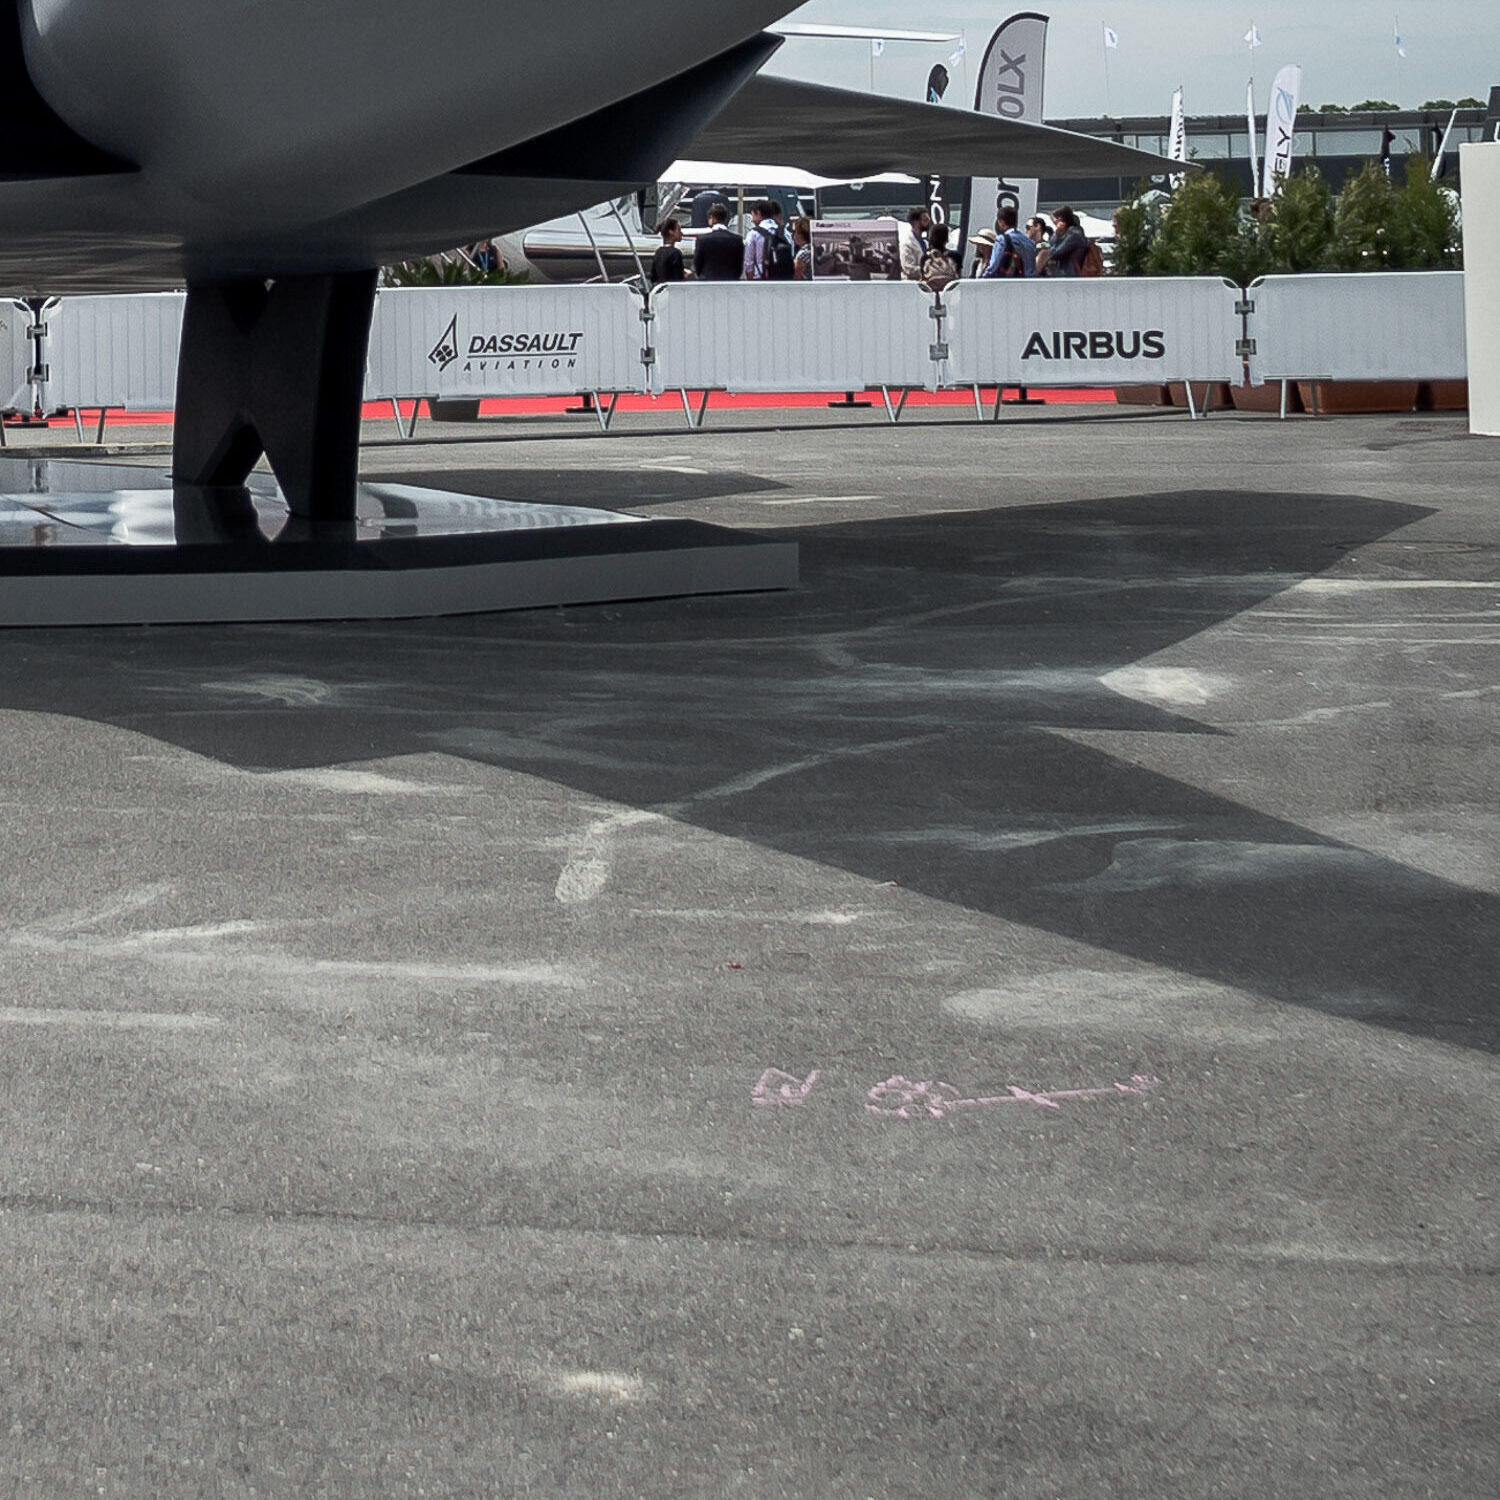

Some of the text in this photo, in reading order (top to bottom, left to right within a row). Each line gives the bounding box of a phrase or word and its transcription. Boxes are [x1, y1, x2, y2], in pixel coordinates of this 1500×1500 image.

[468, 332, 584, 354] DASSAULT
[1021, 330, 1166, 360] AIRBUS
[463, 358, 577, 372] AVIATION
